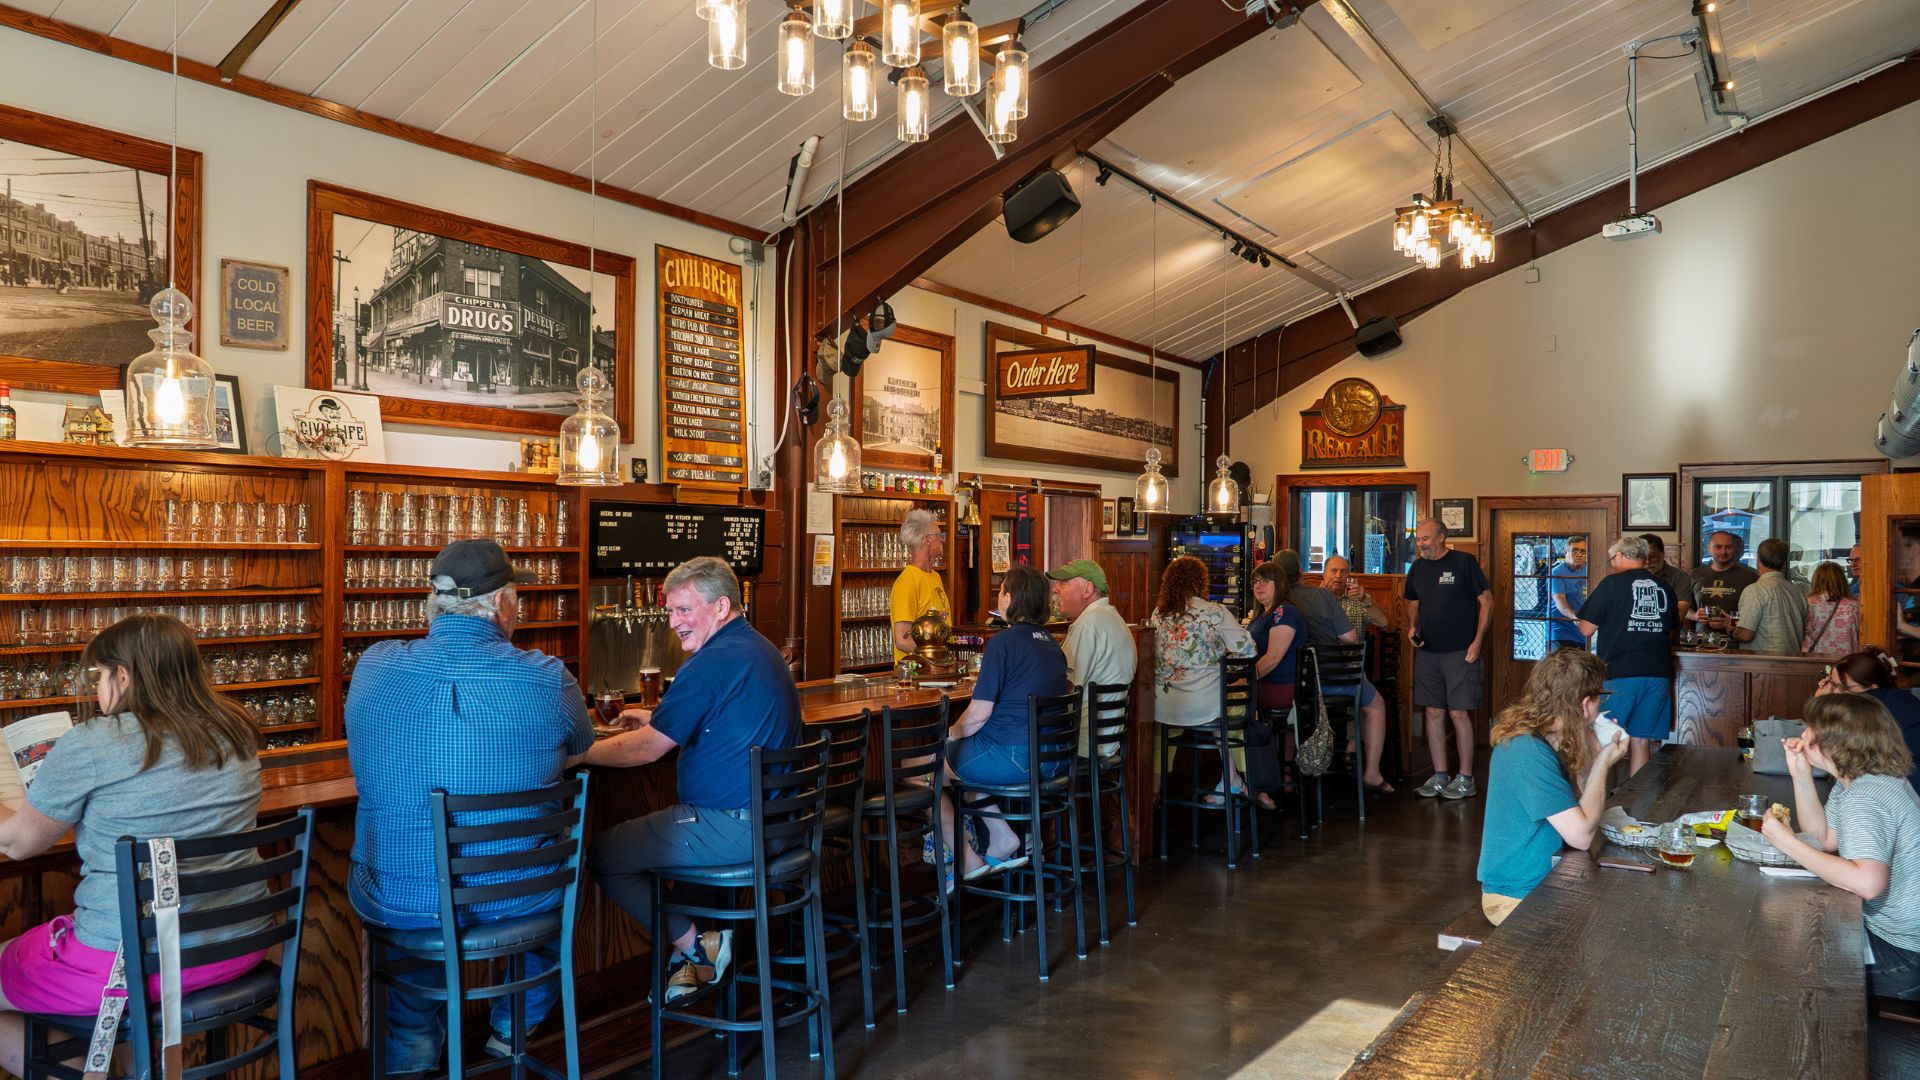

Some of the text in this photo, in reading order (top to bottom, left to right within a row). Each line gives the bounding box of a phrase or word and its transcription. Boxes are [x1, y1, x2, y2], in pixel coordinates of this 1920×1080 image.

[238, 278, 276, 293] COLD
[665, 258, 736, 304] CIVIL BREW
[234, 297, 281, 314] LOCAL
[455, 296, 507, 310] CHIPPEWA
[447, 307, 513, 333] DRUGS
[671, 306, 710, 321] GERMAN WHEAT
[237, 317, 275, 333] BEER
[524, 308, 555, 337] PEVELY
[672, 318, 709, 333] NITRO PUB ALE
[673, 342, 710, 356] VIENNA LAGER
[705, 336, 714, 347] IPA
[672, 354, 713, 369] DRY-HOP RED ALE
[1007, 356, 1079, 388] Order Here
[673, 403, 696, 414] AMERICAN
[696, 406, 711, 416] BROWN
[711, 408, 720, 417] ALE
[673, 416, 703, 427] BLACK LAGER
[674, 428, 706, 439] MILK STOUT
[1306, 423, 1400, 459] REAL ALE
[1535, 448, 1563, 470] EXIT
[691, 469, 704, 480] PUB
[704, 471, 717, 481] ALE
[1647, 620, 1663, 628] Club
